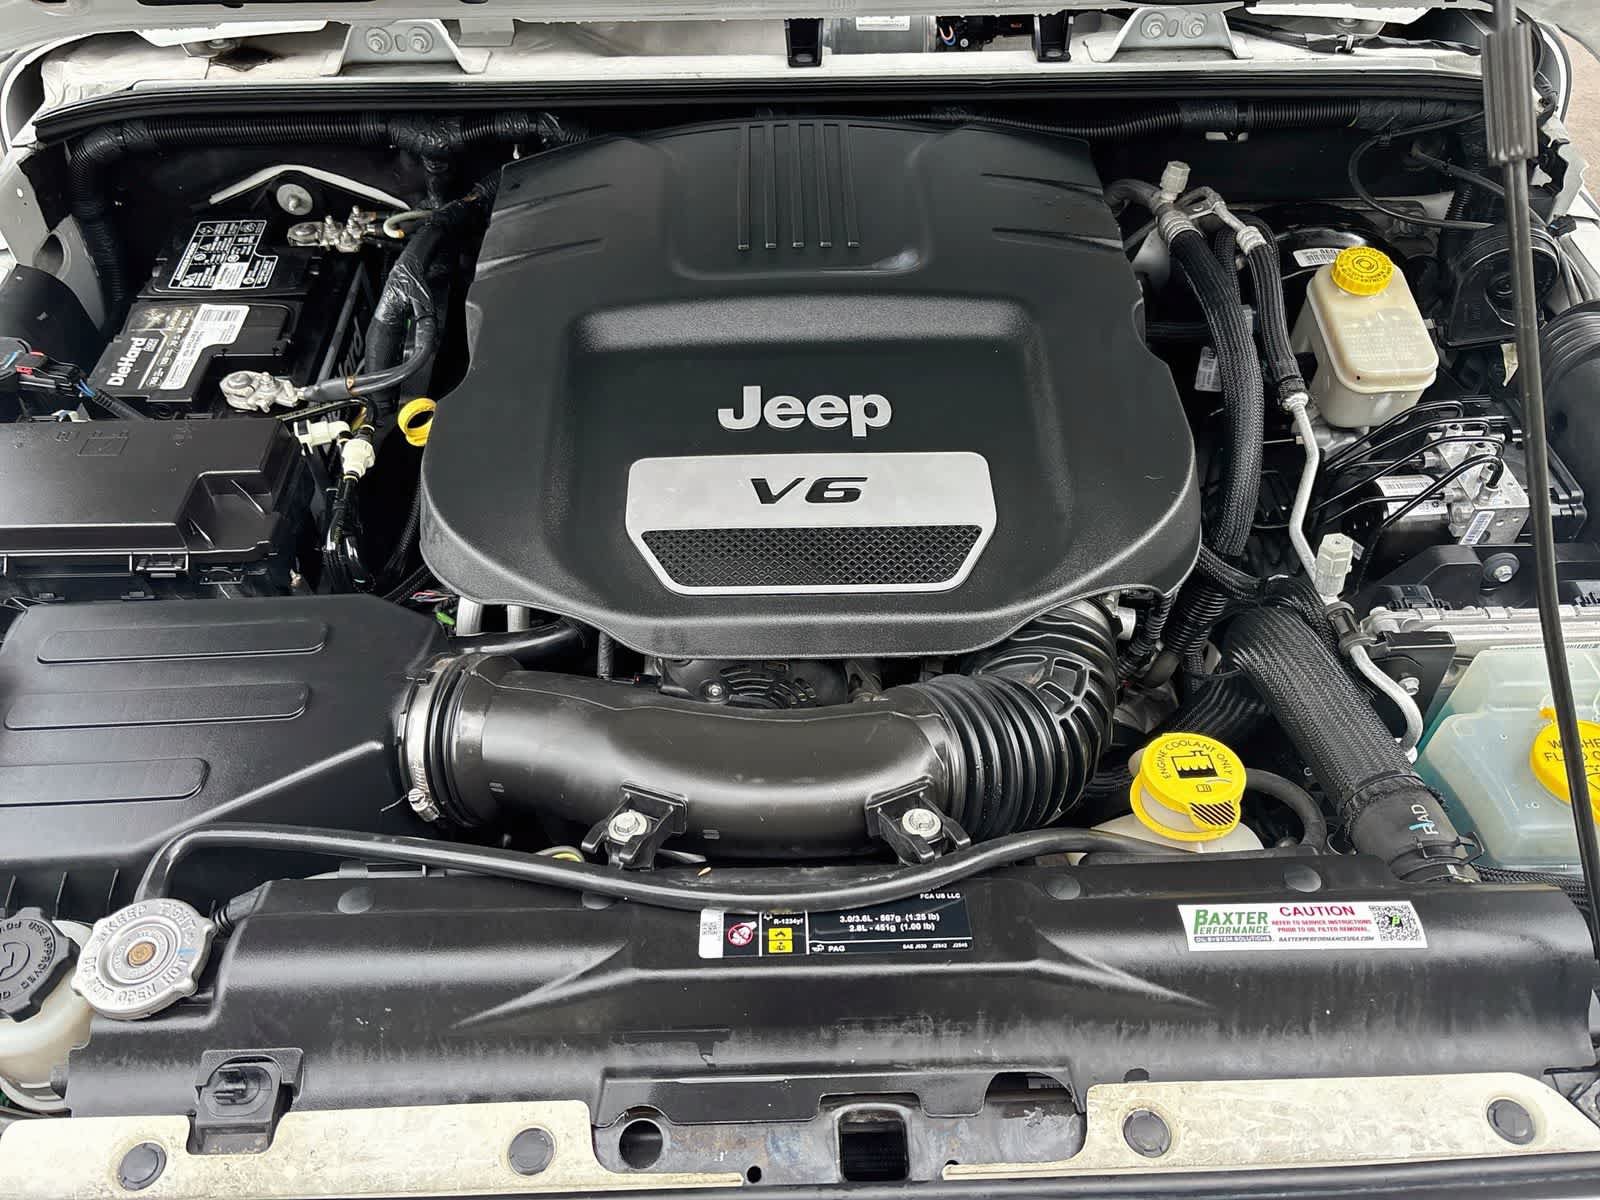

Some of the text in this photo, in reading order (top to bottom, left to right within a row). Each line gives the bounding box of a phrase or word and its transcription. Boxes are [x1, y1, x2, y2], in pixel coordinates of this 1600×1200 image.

[106, 337, 147, 387] DieHard
[717, 385, 893, 438] Jeep
[750, 476, 869, 505] V6
[1156, 739, 1233, 780] ENGINE COOLANT ONLY
[1410, 804, 1440, 835] RAD
[1194, 909, 1269, 934] BAXTER
[1279, 905, 1356, 917] CAUTION
[827, 944, 846, 953] PAG
